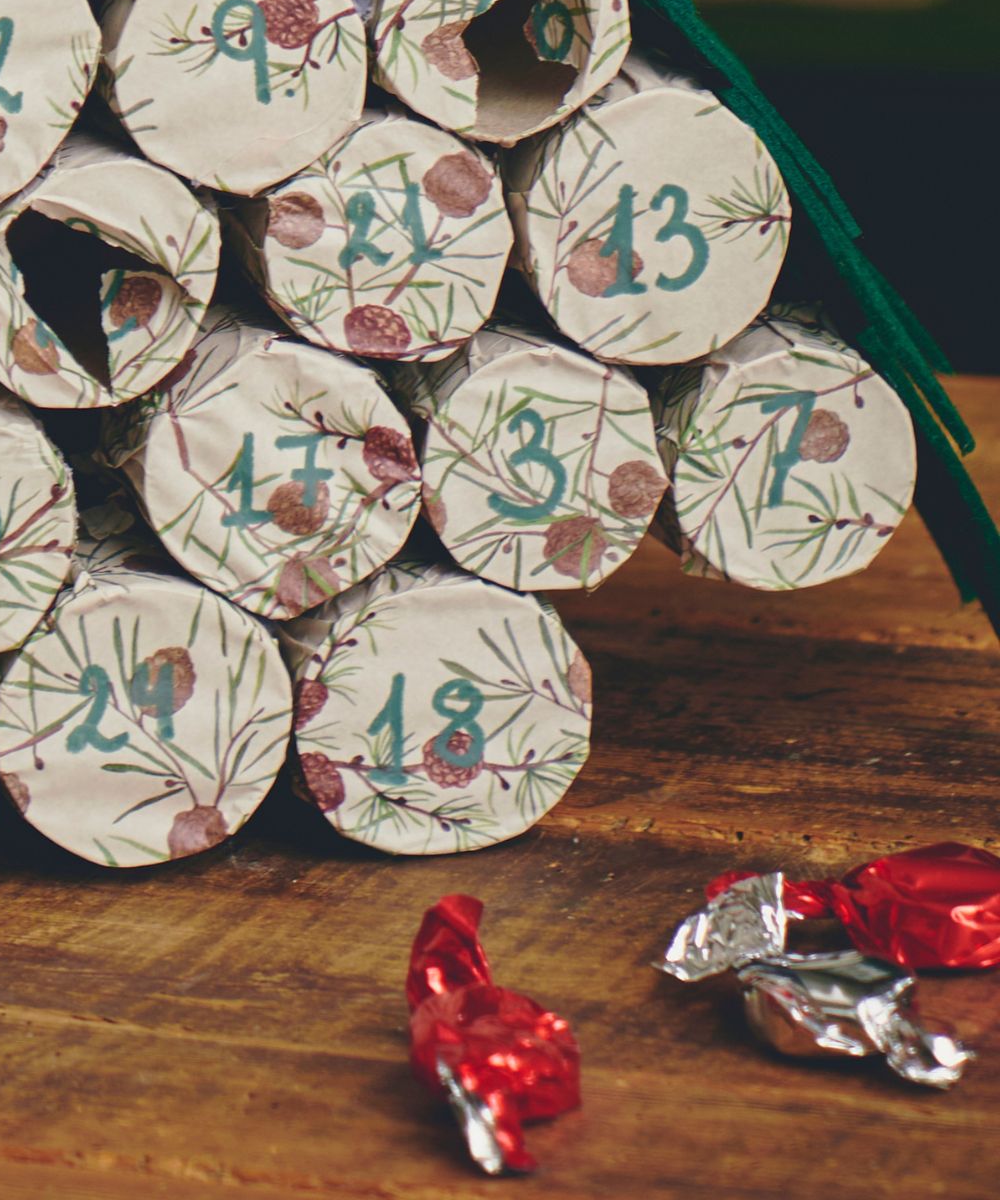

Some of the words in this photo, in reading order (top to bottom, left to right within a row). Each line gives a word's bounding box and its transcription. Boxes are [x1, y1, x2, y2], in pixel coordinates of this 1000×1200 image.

[338, 183, 442, 265] 21
[603, 183, 710, 295] 13
[221, 432, 334, 526] 17
[488, 408, 567, 519] 3
[762, 391, 816, 506] 7
[65, 663, 175, 754] 24
[367, 673, 485, 784] 18
